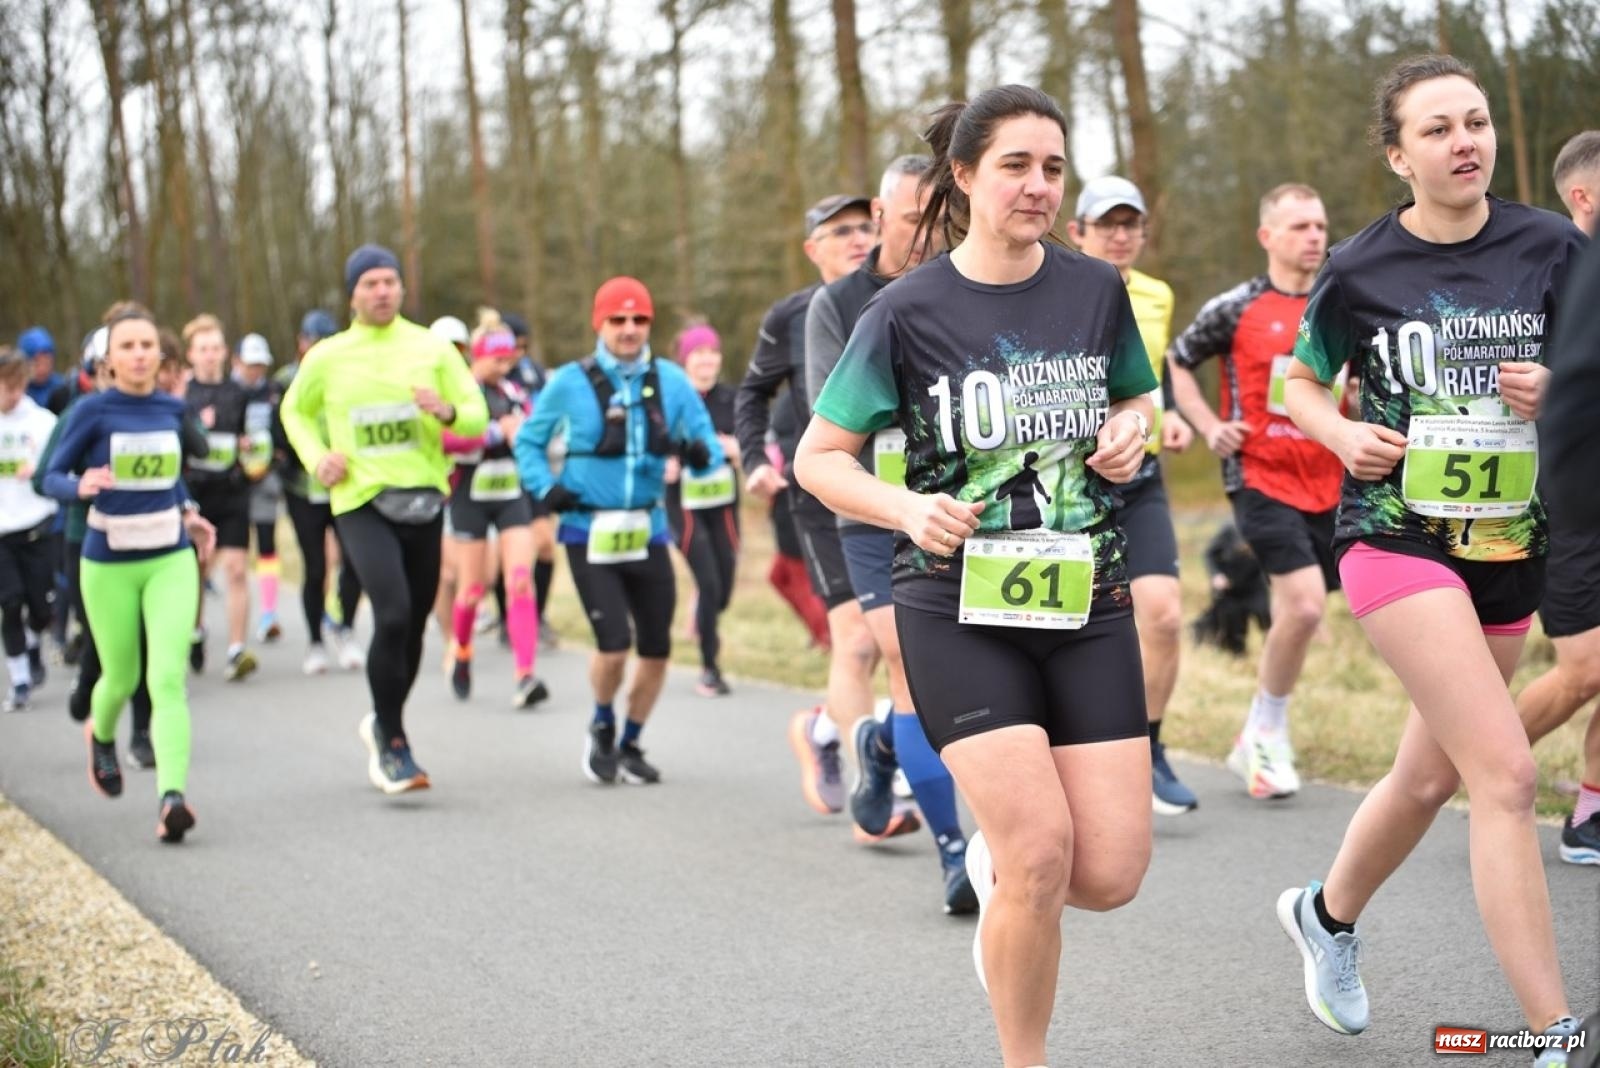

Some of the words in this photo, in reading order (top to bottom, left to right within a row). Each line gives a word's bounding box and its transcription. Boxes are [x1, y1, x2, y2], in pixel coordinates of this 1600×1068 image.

[1441, 309, 1545, 339] KUŹNIAŃSKI
[1372, 320, 1437, 395] 10
[1443, 344, 1516, 361] PÓŁMARATON
[1008, 353, 1106, 387] KUŹNIAŃSKI
[1444, 364, 1500, 396] RAFA
[928, 369, 1006, 452] 10
[1013, 387, 1086, 409] PÓŁMARATON
[364, 420, 411, 447] 105
[1014, 407, 1109, 444] RAFAME
[132, 455, 163, 479] 62
[1440, 453, 1501, 499] 51
[613, 531, 635, 552] 11
[1001, 561, 1063, 609] 61
